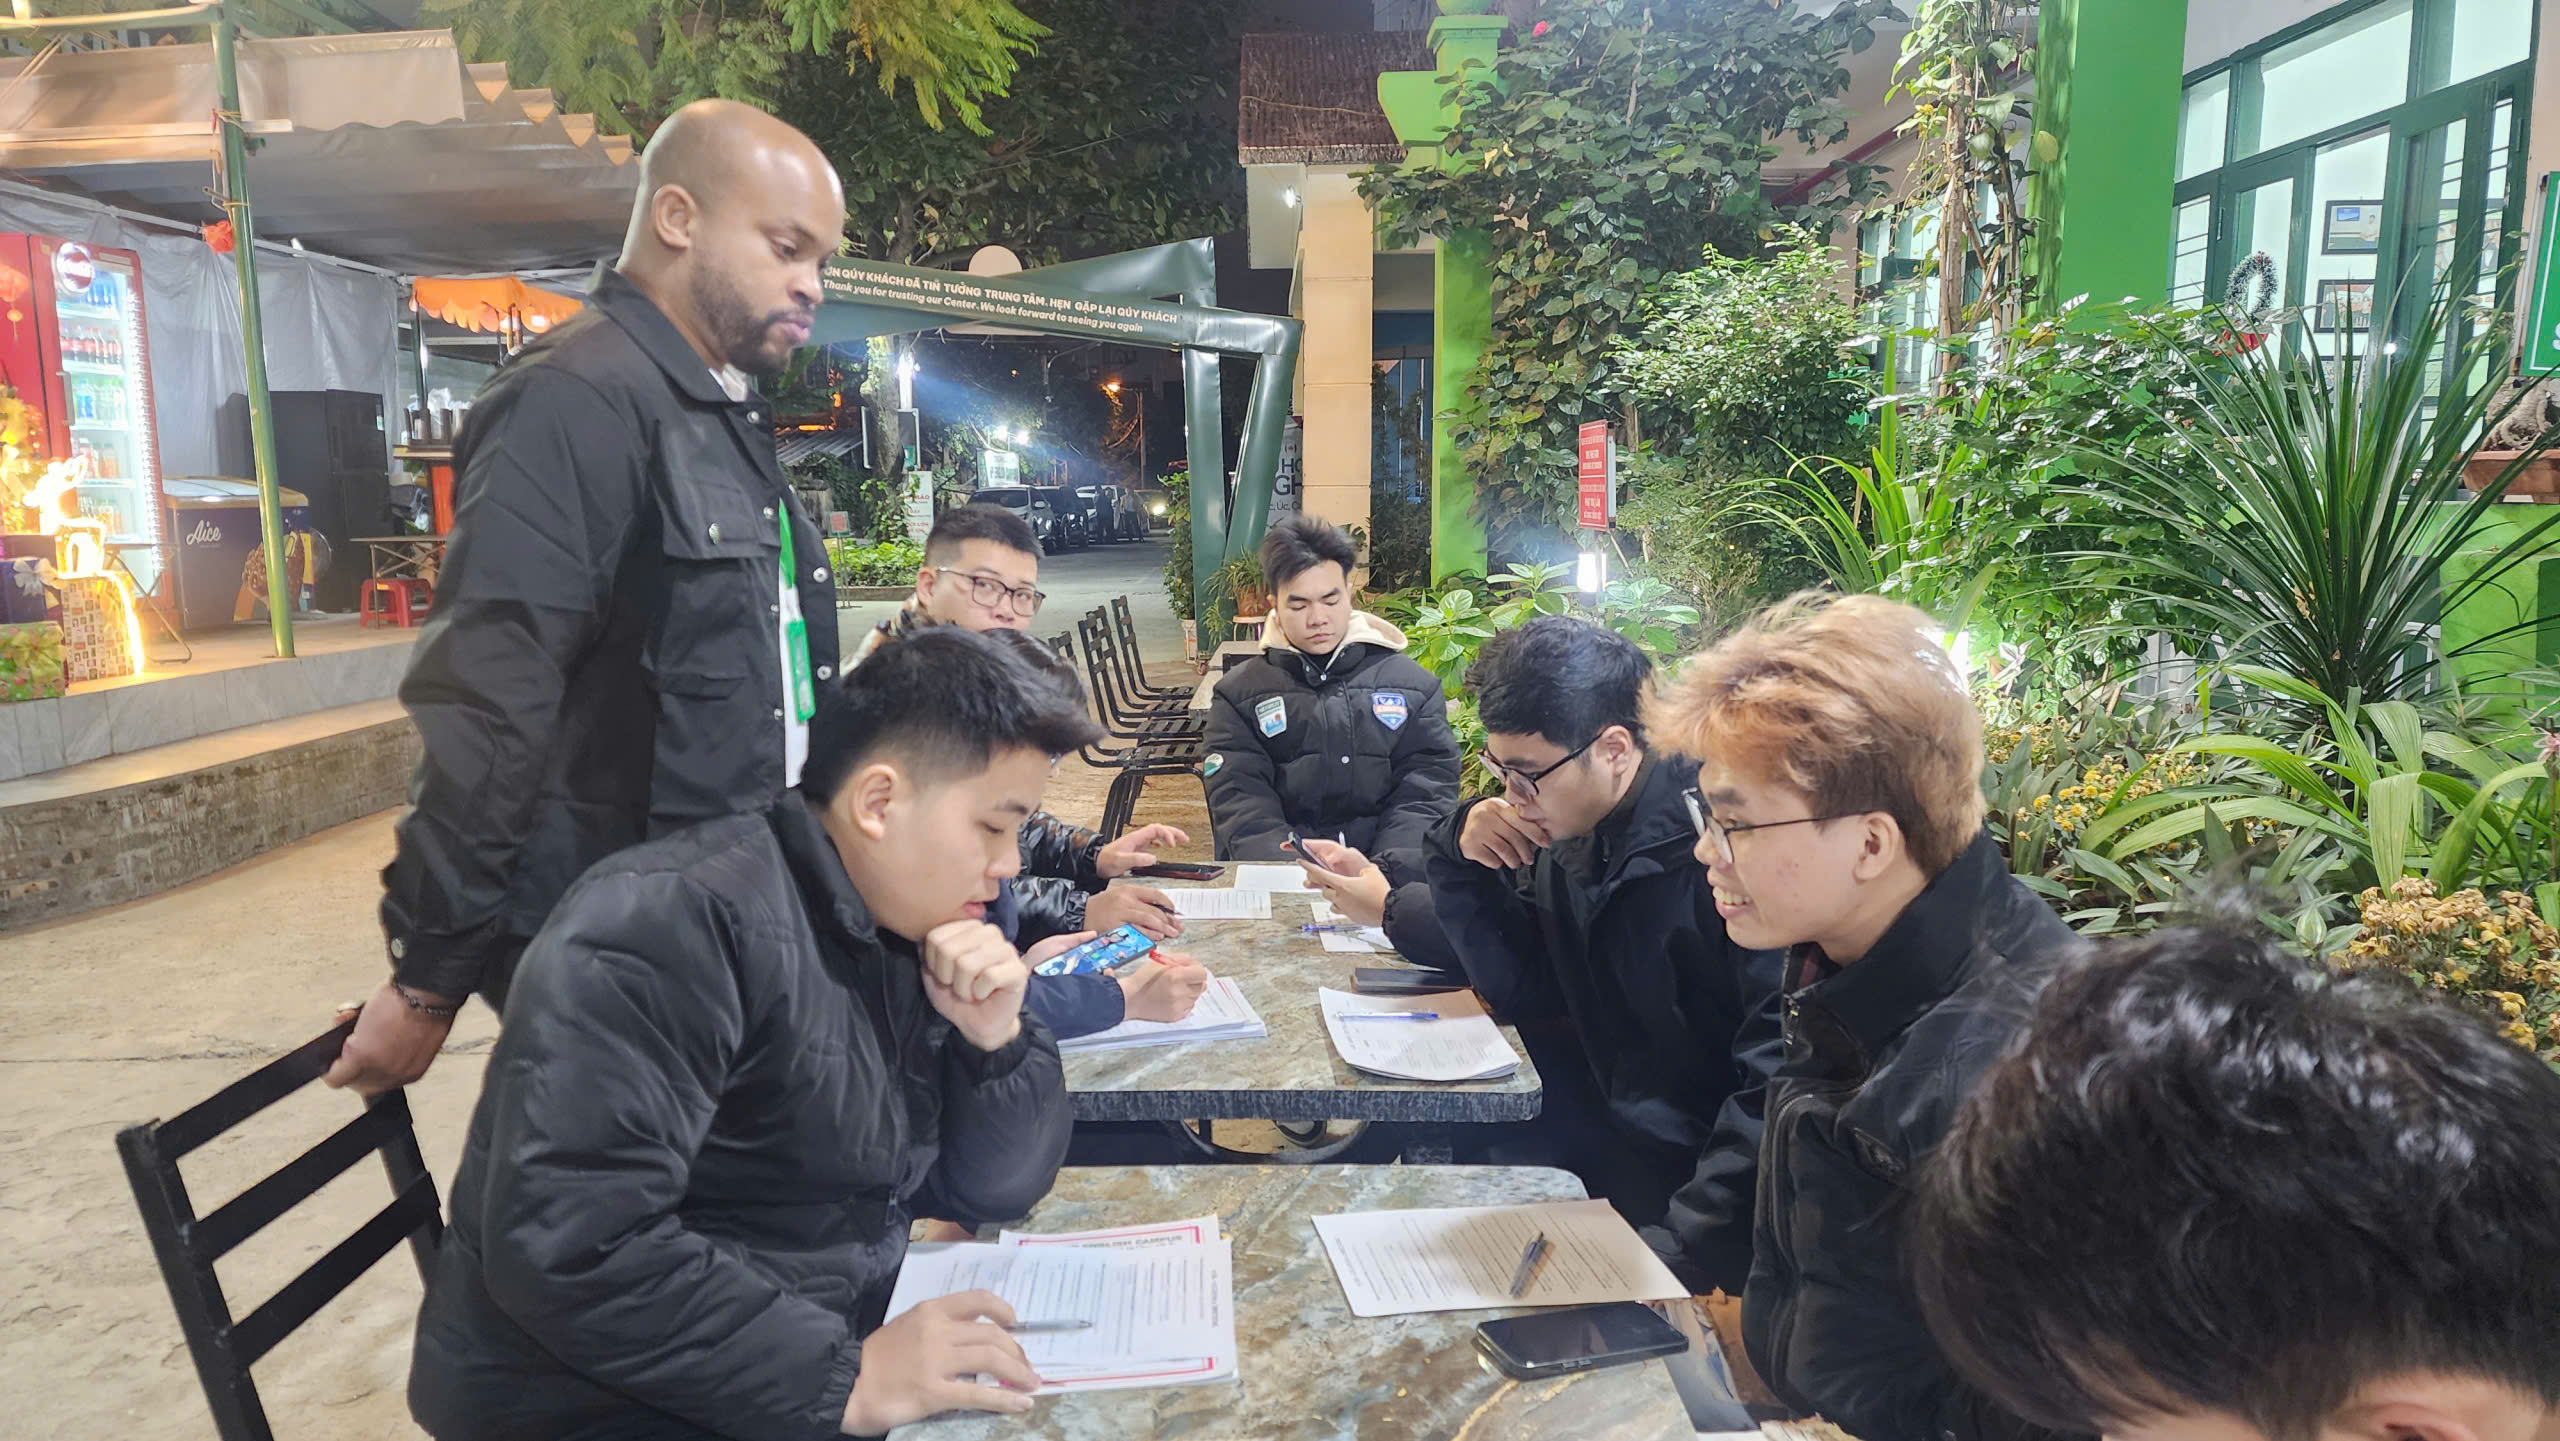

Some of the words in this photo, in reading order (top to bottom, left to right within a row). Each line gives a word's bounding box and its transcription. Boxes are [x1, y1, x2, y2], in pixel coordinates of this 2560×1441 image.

[823, 280, 852, 292] Thank
[854, 285, 871, 295] you
[872, 286, 887, 297] for
[888, 289, 925, 304] trusting
[926, 296, 943, 305] our
[943, 296, 979, 310] Center.
[980, 301, 995, 312] We
[996, 304, 1016, 315] look
[1018, 307, 1056, 321] forward
[1057, 311, 1066, 321] to
[1067, 316, 1098, 328] seeing
[1099, 320, 1117, 329] you
[1117, 323, 1143, 332] again
[985, 289, 1021, 303] TRUNG
[1050, 297, 1071, 311] HẸN
[1098, 305, 1116, 317] LẠI
[186, 519, 221, 545] Aice
